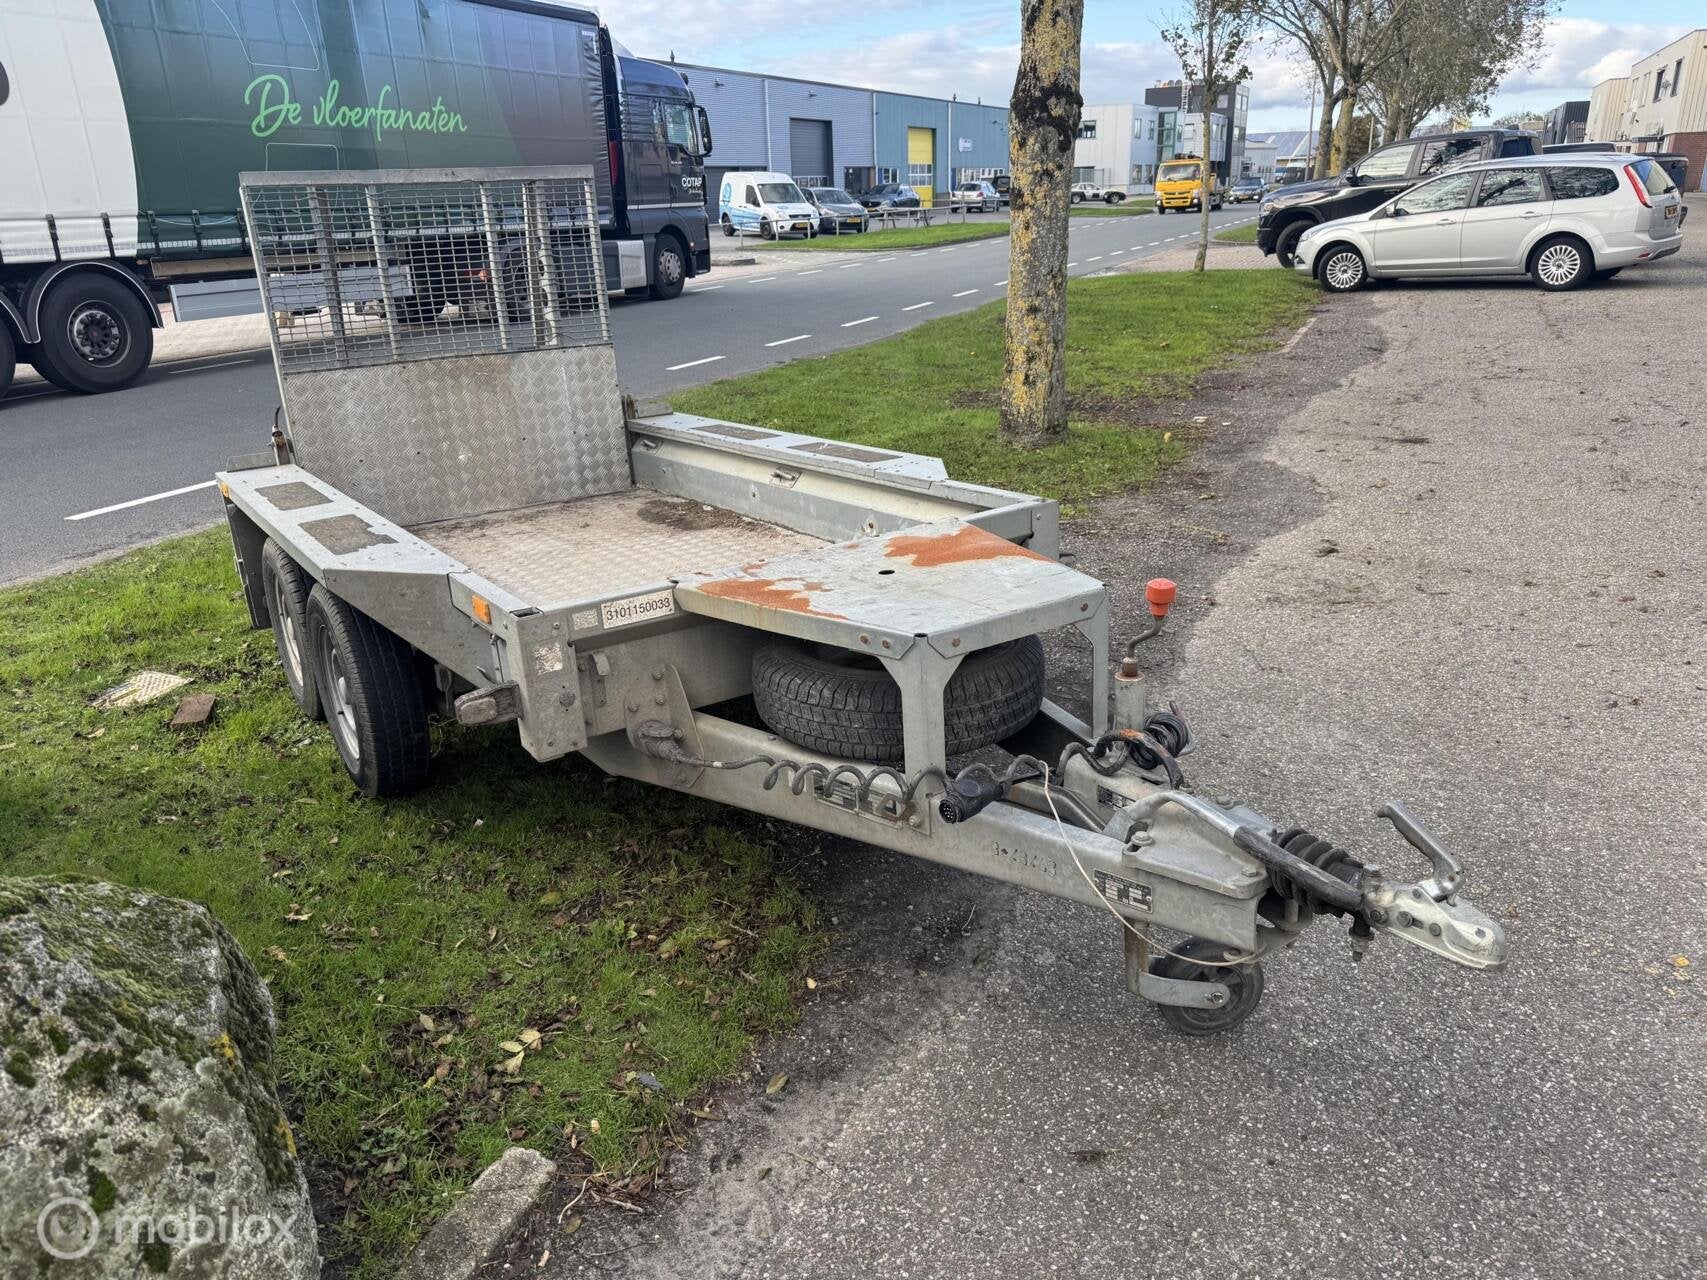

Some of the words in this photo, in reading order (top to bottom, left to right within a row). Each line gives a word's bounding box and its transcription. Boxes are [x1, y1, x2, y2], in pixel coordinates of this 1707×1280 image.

[244, 74, 302, 137] De
[313, 79, 467, 142] vloerfanaten
[606, 597, 671, 621] 3101150033
